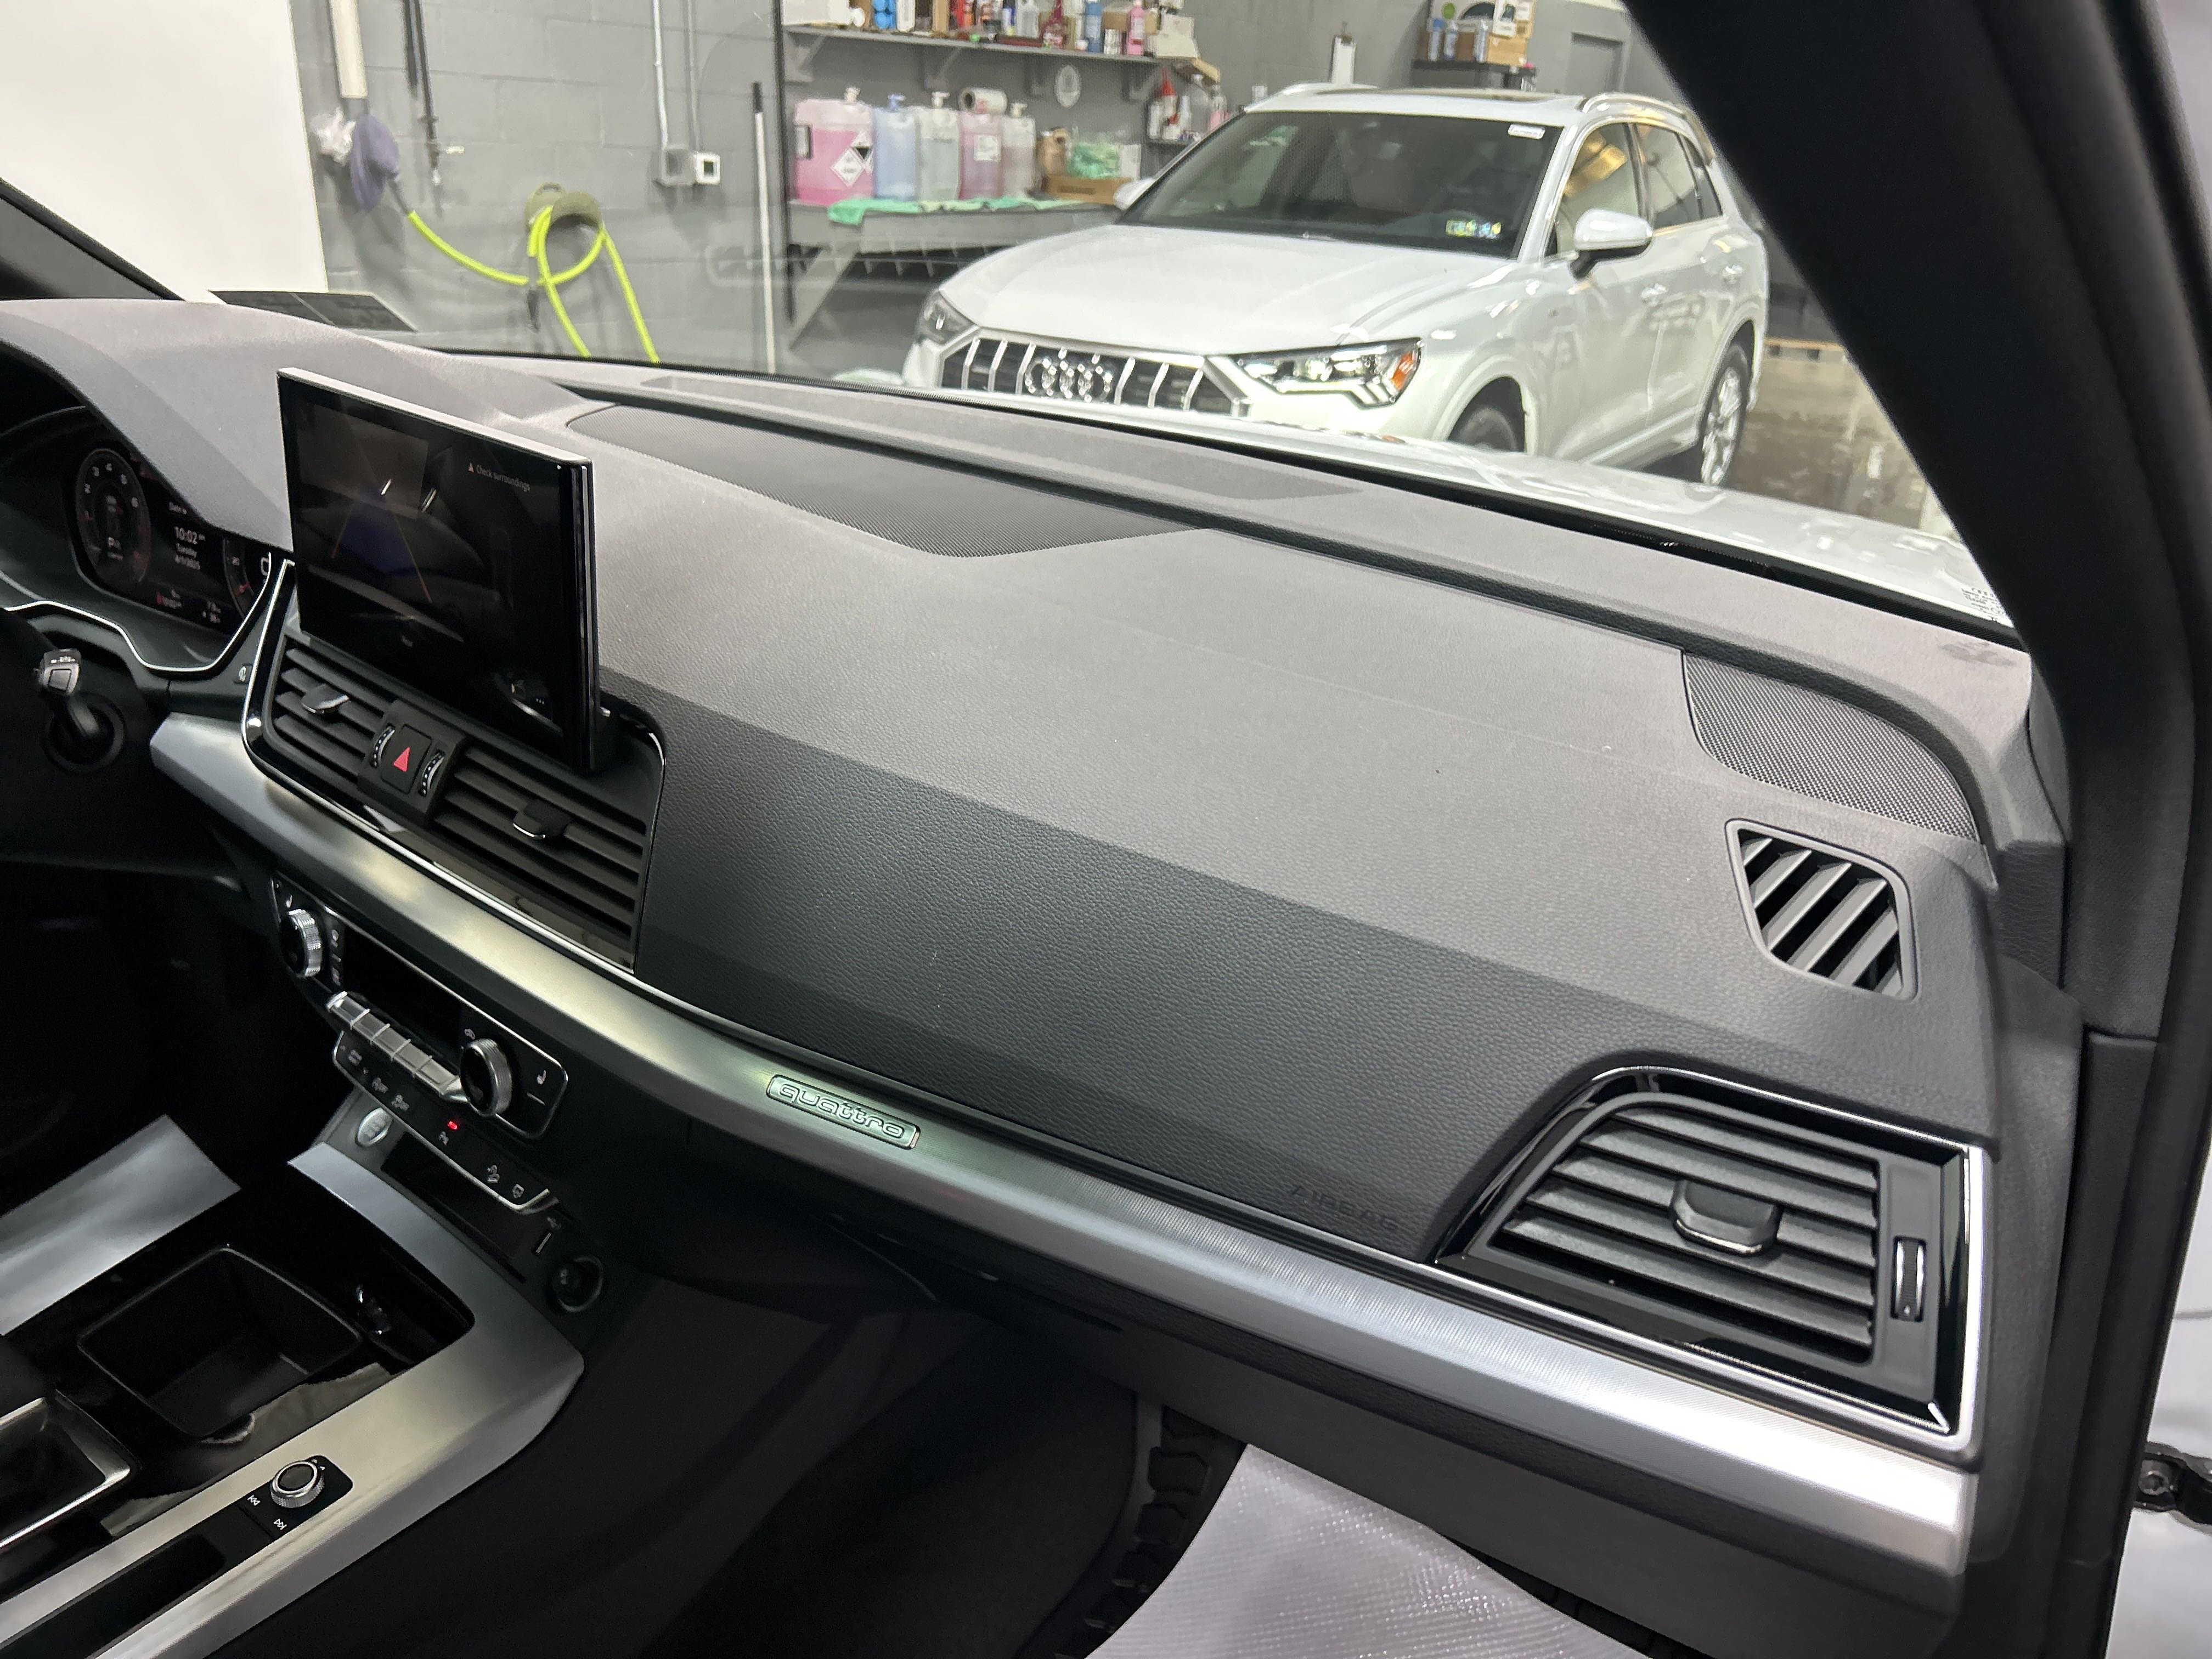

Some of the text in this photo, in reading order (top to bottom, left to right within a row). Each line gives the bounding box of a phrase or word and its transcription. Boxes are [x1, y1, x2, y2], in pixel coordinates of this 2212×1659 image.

[476, 465, 531, 492] Check surroundings
[175, 526, 198, 545] 10:02
[779, 1084, 905, 1138] quattro
[1291, 1185, 1399, 1231] AIRBAG
